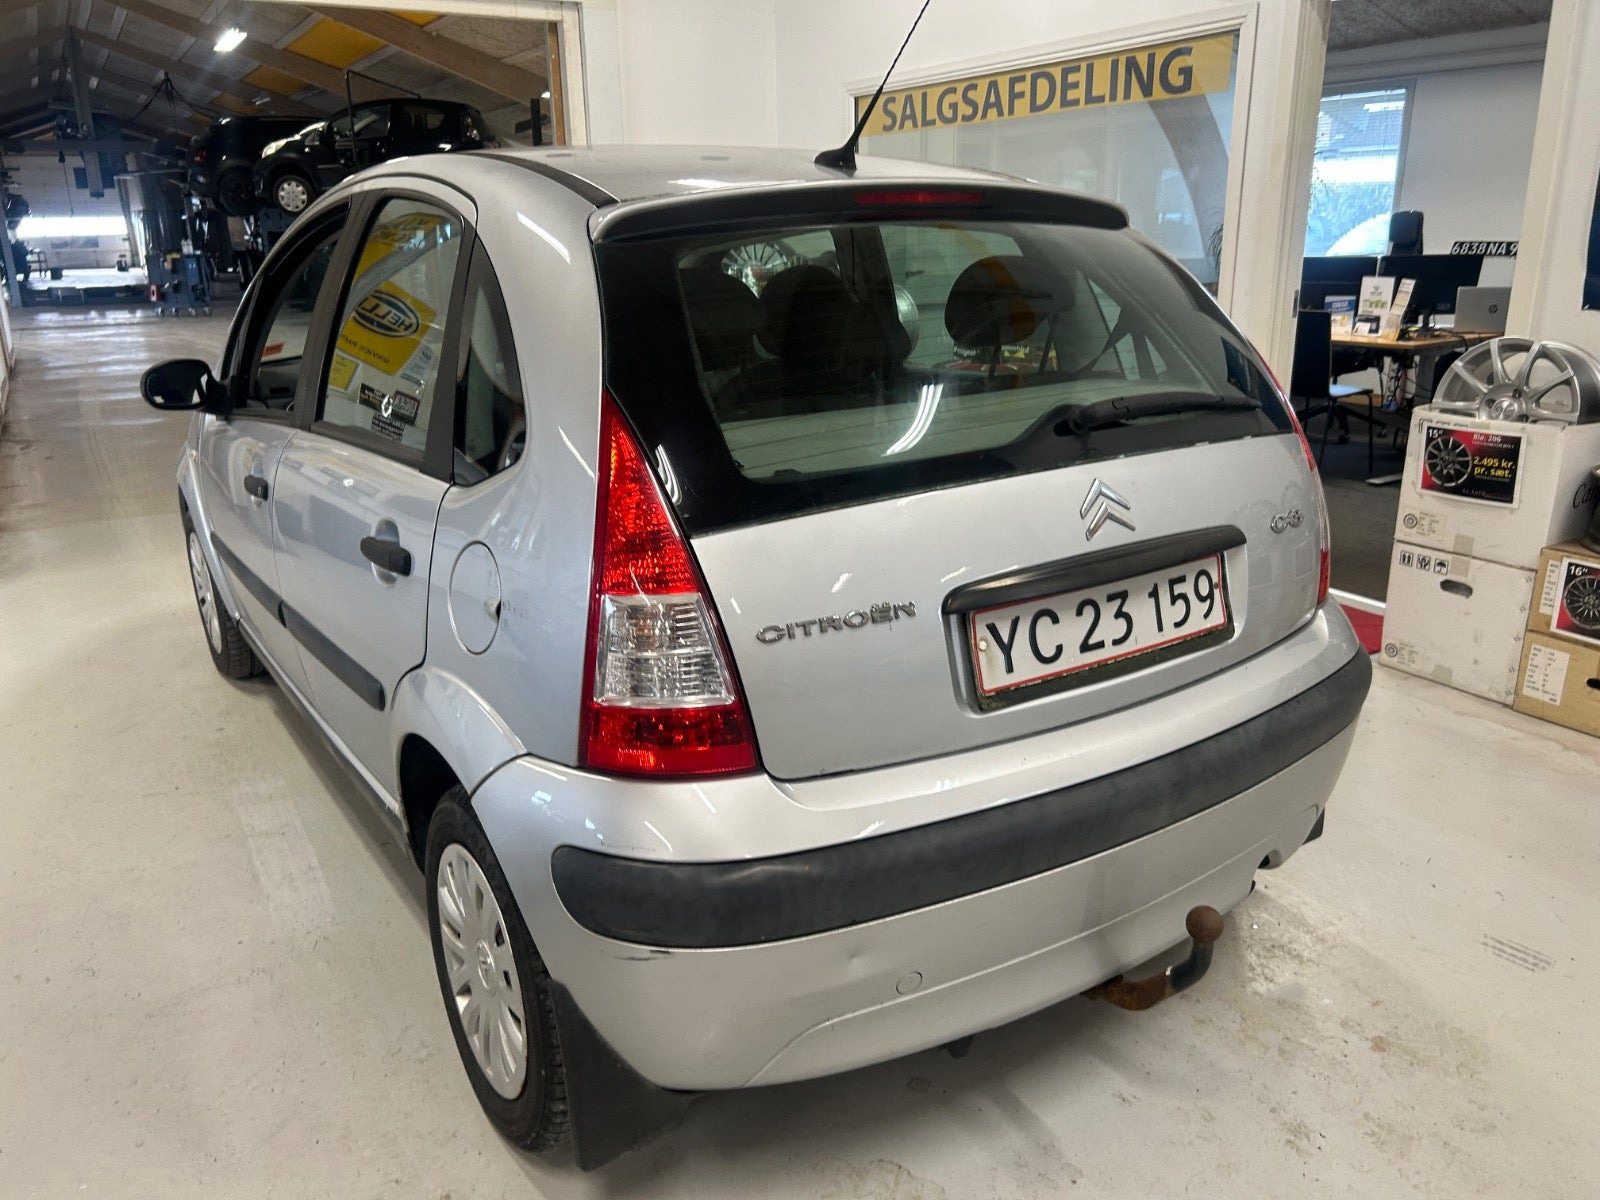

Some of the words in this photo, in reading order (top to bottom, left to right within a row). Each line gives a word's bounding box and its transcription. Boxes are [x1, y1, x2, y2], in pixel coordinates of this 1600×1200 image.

[882, 46, 1194, 132] SALGSAFDELING
[1473, 456, 1499, 467] 2.495
[1501, 459, 1515, 470] kr.
[1474, 466, 1488, 478] pr.
[1270, 510, 1303, 534] C3
[756, 601, 917, 644] CITROËN
[986, 608, 1063, 673] YC
[1076, 589, 1133, 653] 23
[1148, 569, 1214, 632] 159
